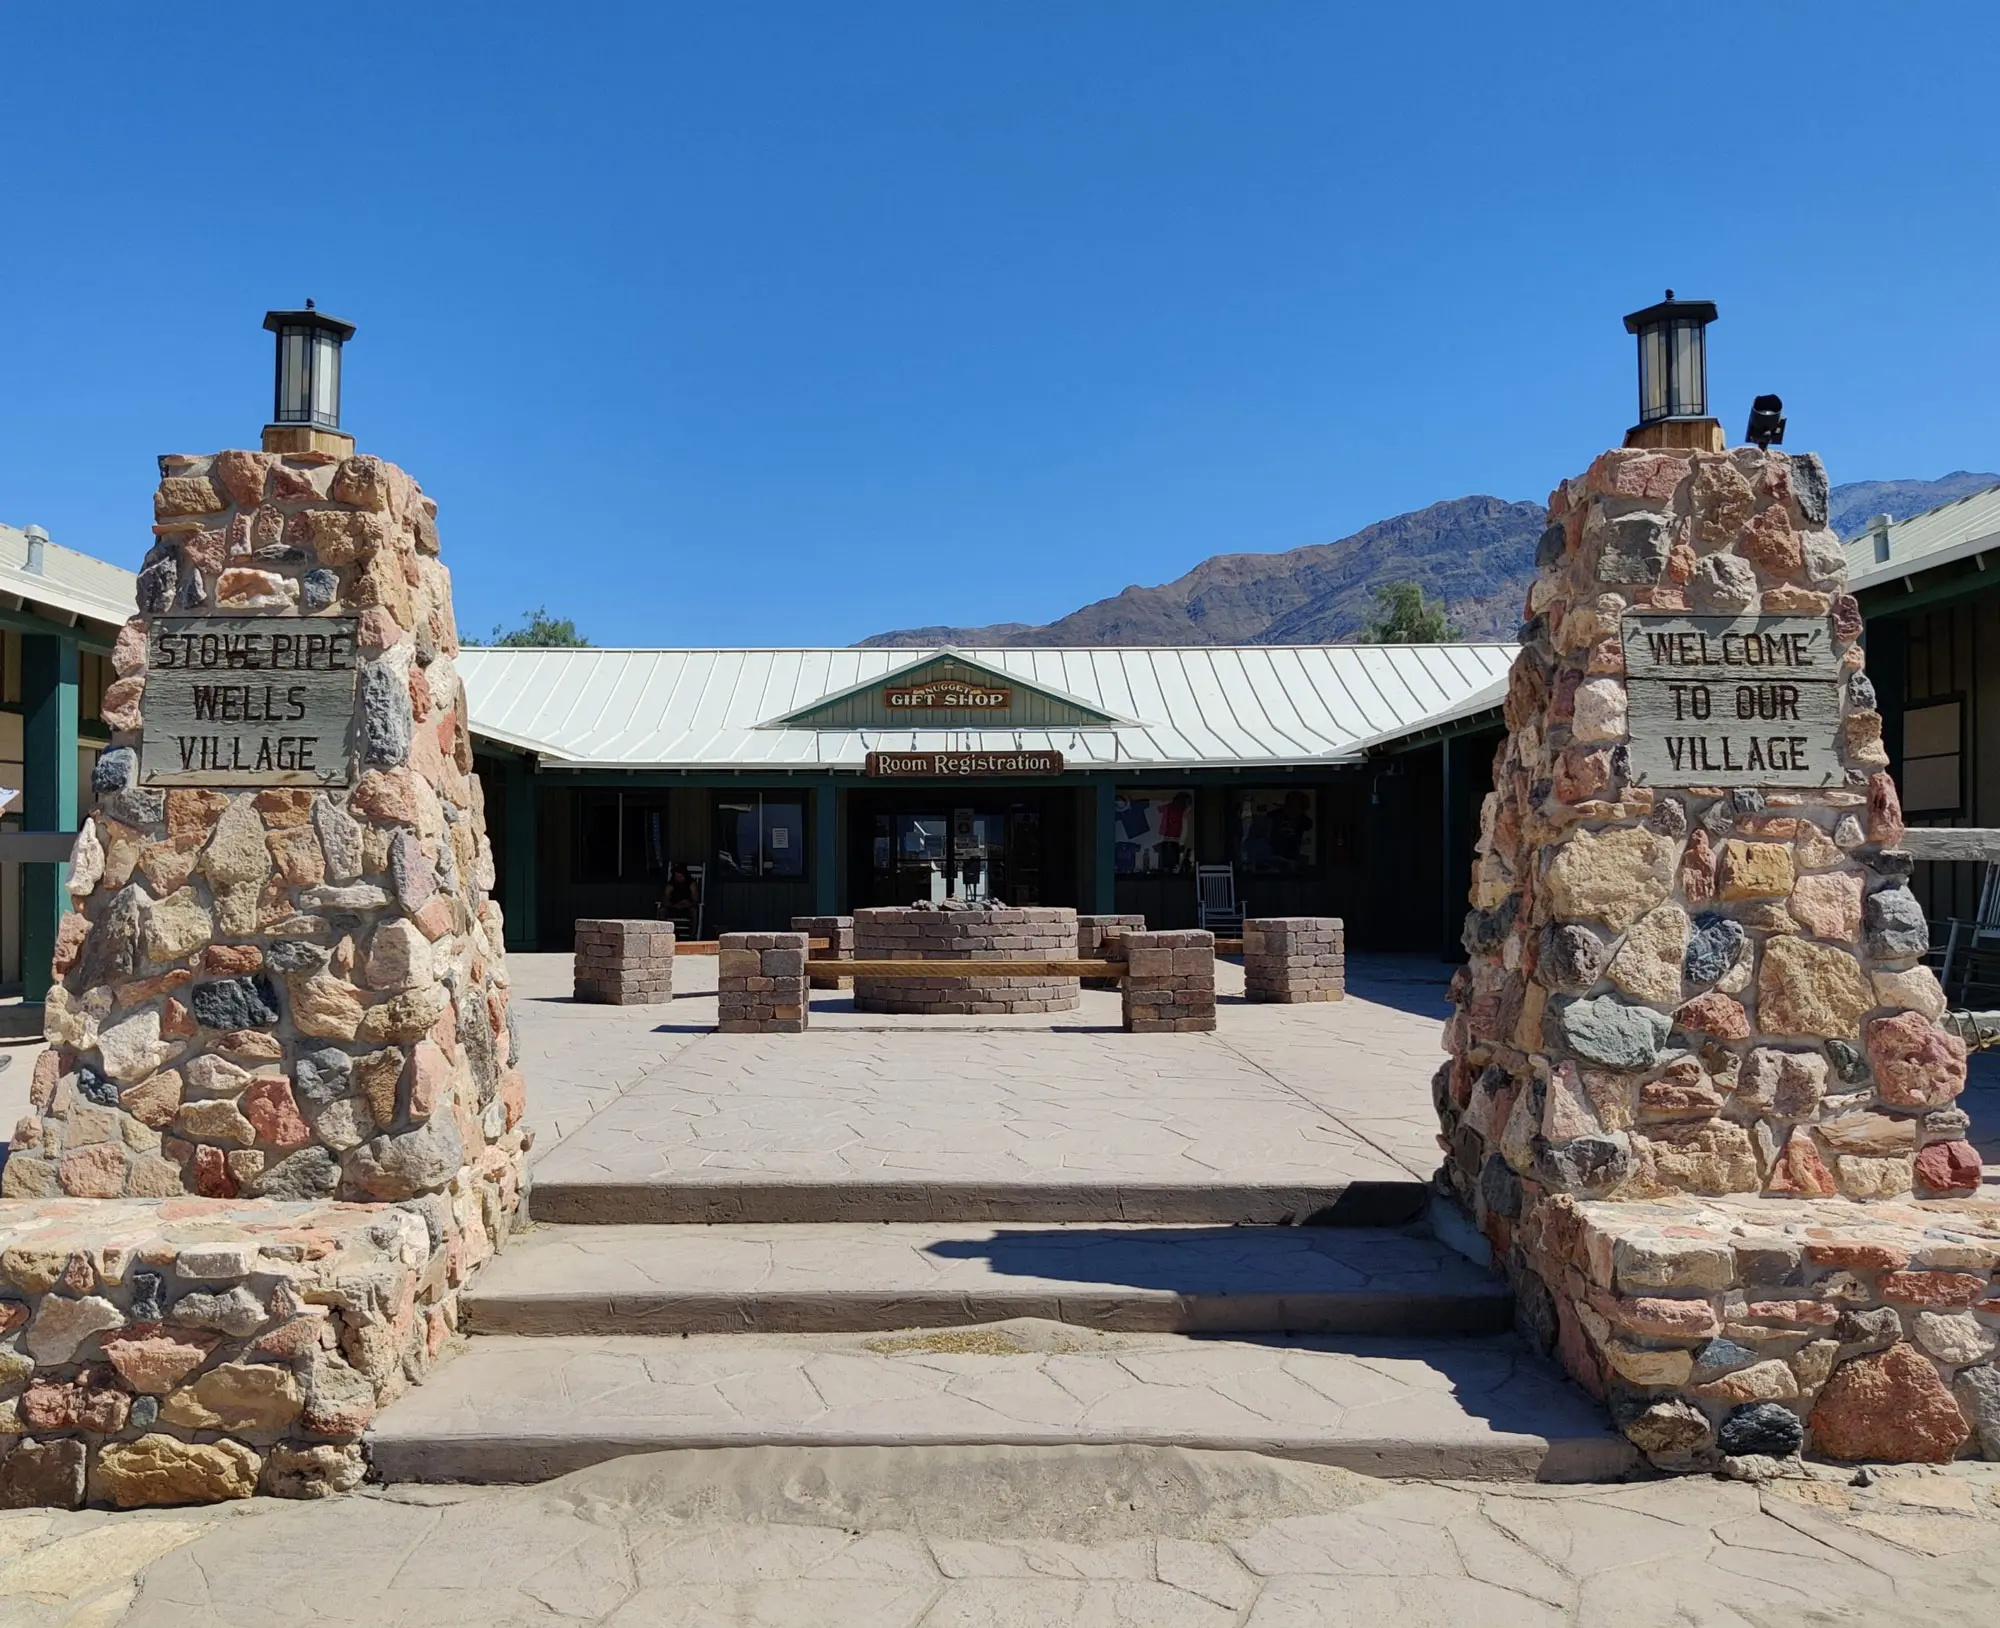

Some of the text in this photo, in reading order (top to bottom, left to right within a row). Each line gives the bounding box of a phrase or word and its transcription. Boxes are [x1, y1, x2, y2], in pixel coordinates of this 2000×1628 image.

[157, 633, 350, 668] STOVE PIPE
[1646, 632, 1813, 666] WELCOME
[192, 685, 307, 721] WELLS
[891, 694, 1004, 706] GIFT SHOP
[924, 684, 970, 695] NUGGET
[1669, 685, 1800, 720] TO OUR
[177, 736, 320, 770] VILLAGE
[878, 753, 1051, 775] Room Registration
[1664, 736, 1810, 771] VILLAGE
